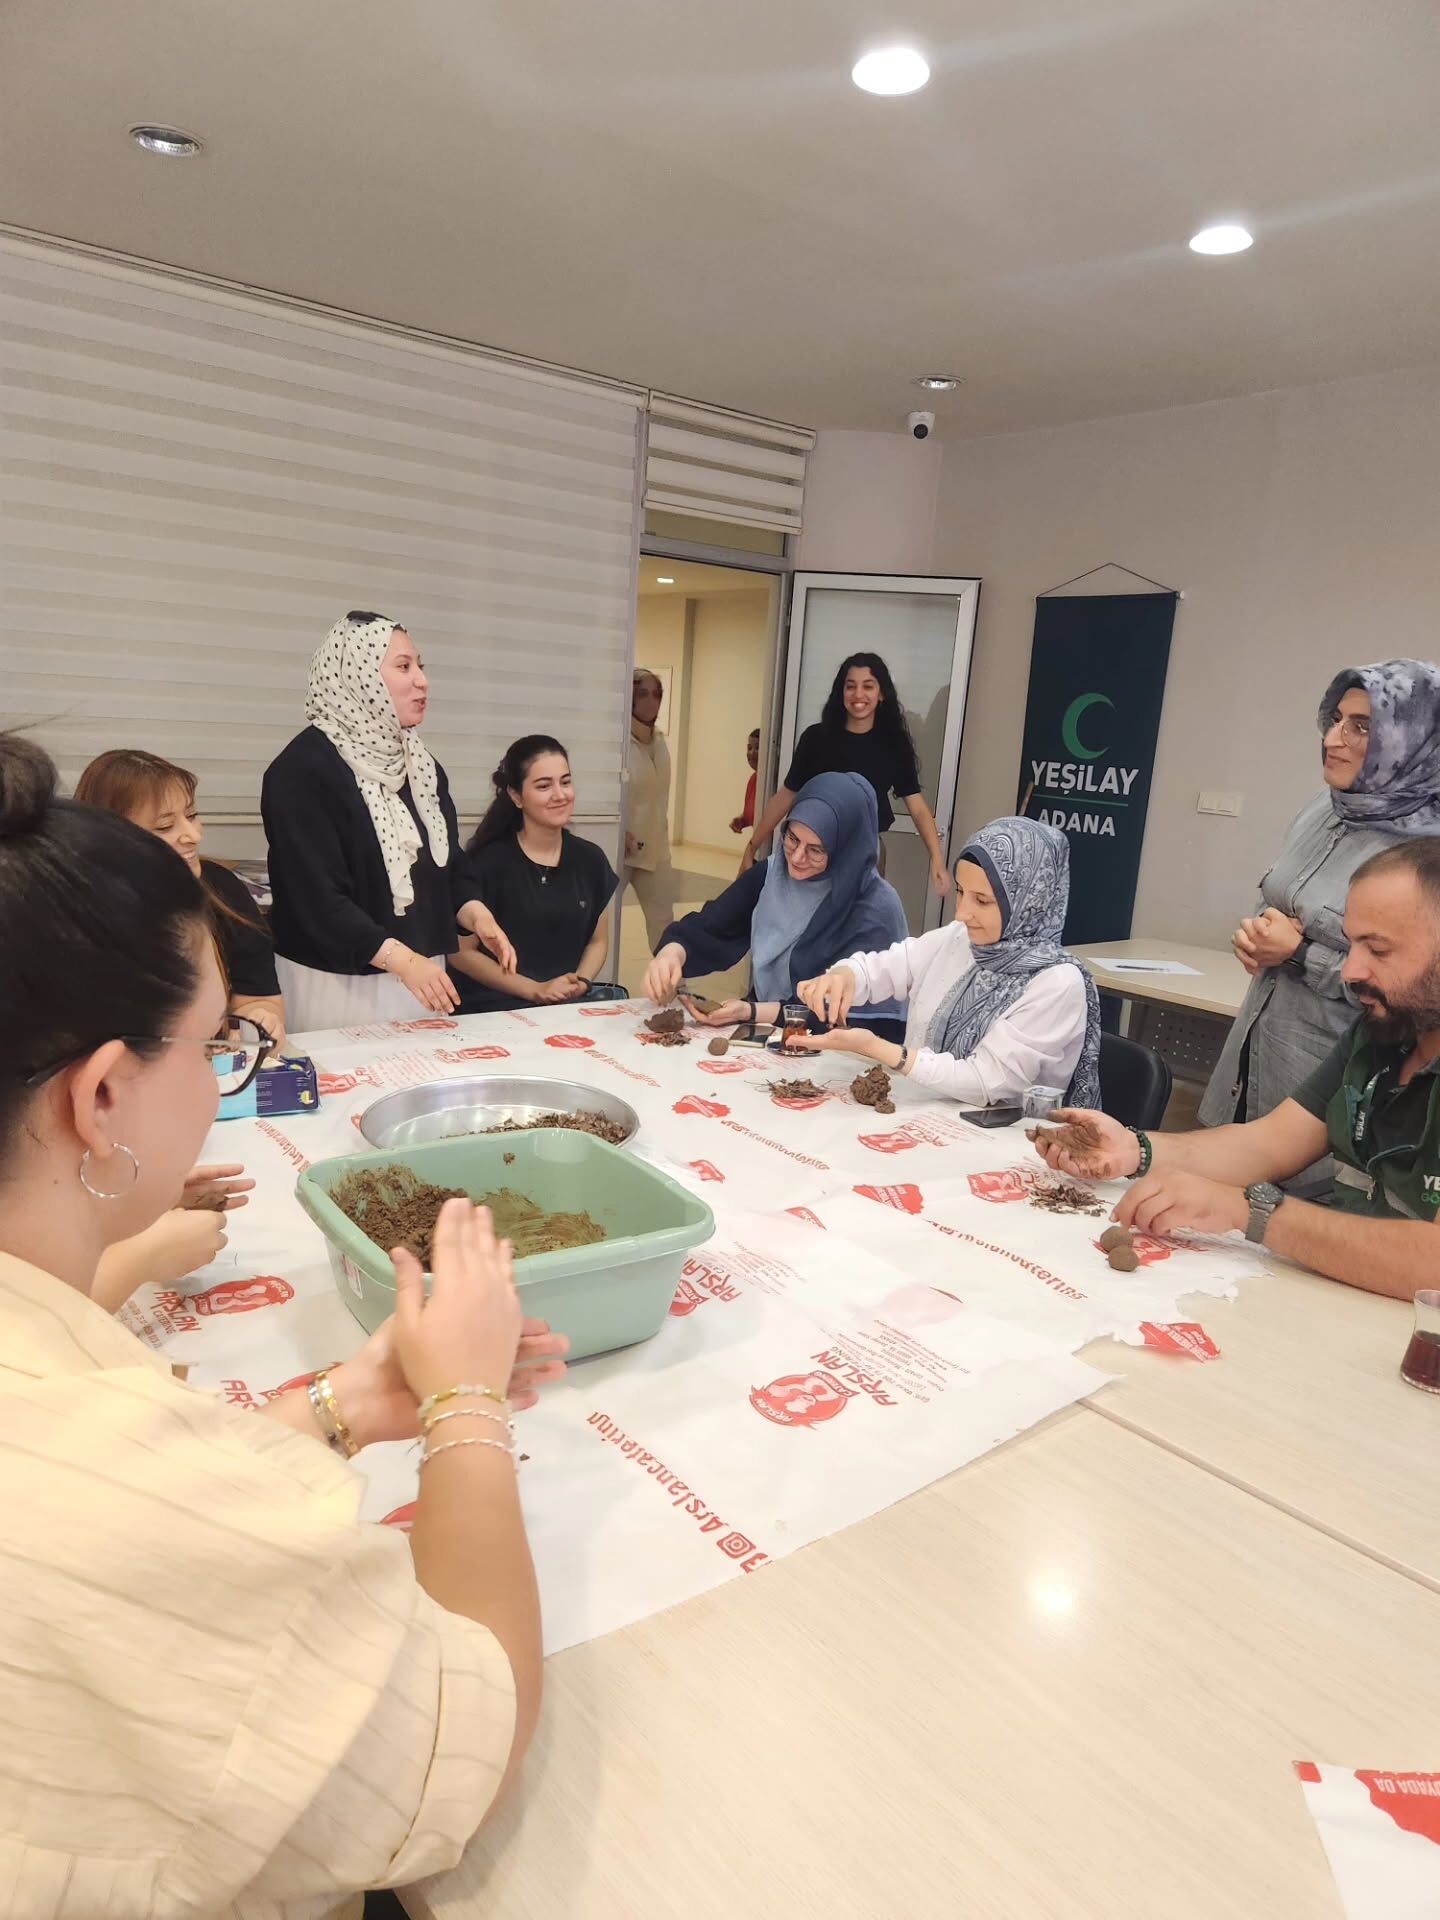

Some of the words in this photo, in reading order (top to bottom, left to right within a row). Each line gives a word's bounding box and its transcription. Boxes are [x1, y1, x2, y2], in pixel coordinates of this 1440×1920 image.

[1038, 808, 1116, 837] ADANA
[1423, 1174, 1440, 1193] YE
[680, 1258, 742, 1303] ARSLA
[810, 1350, 898, 1406] ARSLAN
[586, 1411, 730, 1533] Arslancatering
